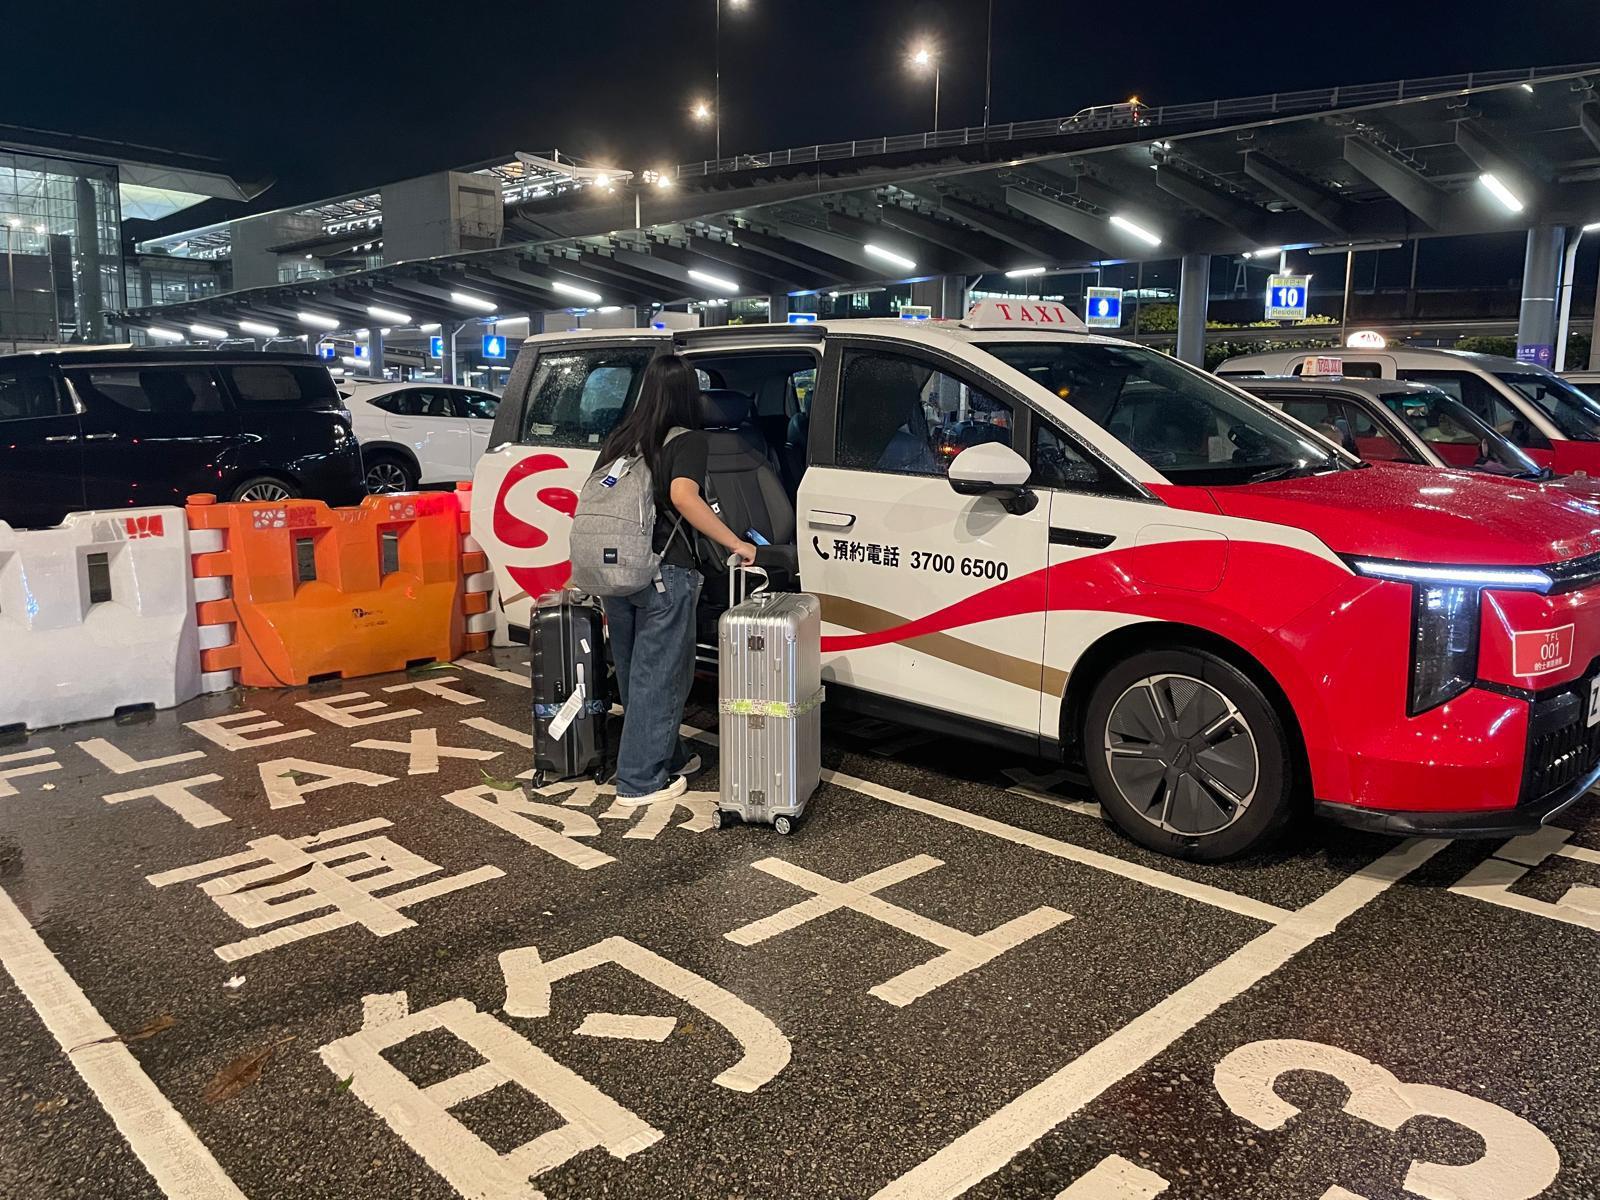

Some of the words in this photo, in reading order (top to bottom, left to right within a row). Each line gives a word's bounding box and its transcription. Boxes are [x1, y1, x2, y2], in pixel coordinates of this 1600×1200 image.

[1279, 288, 1298, 307] 10
[996, 303, 1066, 323] TAXI
[1098, 299, 1109, 316] 9
[488, 337, 500, 356] 4
[1317, 359, 1342, 373] TAXI
[833, 539, 900, 568] 預約電話
[910, 550, 955, 574] 3700
[960, 557, 1009, 581] 6500
[1545, 632, 1559, 644] TFL
[1540, 641, 1560, 660] 001
[102, 717, 536, 828] TAXI
[319, 854, 1074, 1200] 的士
[1213, 1038, 1560, 1200] 3
